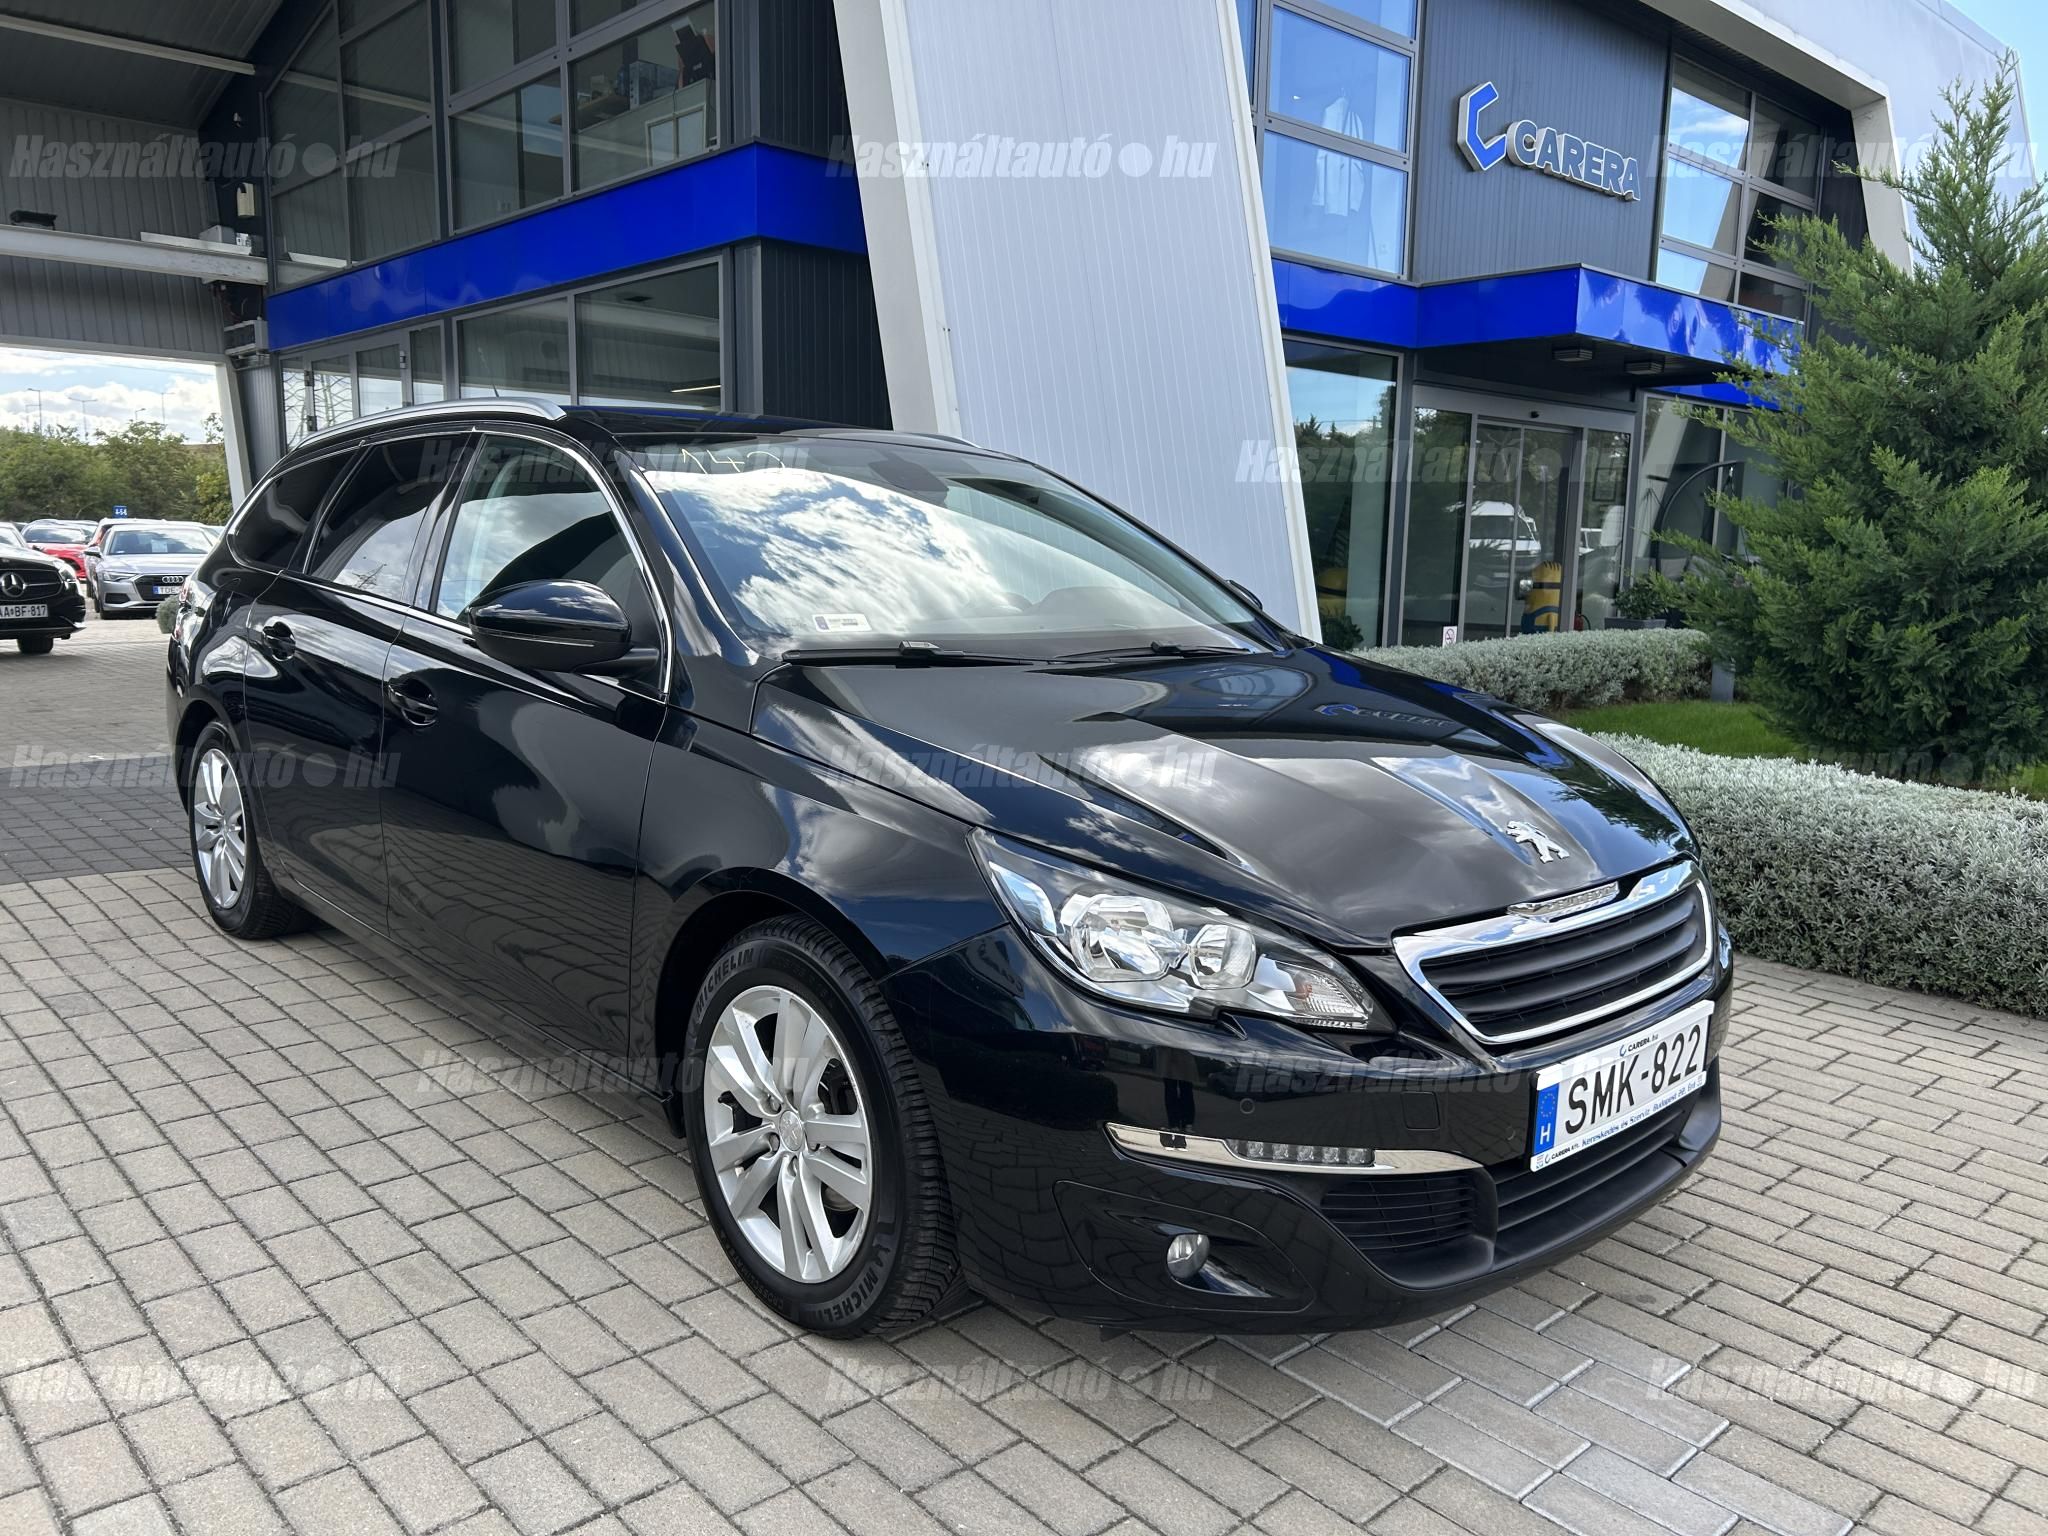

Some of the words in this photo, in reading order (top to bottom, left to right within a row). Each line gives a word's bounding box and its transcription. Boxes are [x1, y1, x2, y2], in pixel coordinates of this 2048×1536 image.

[1507, 120, 1641, 201] CARERA
[696, 947, 754, 1017] MICHELIN
[1565, 1024, 1701, 1134] SMK-822
[1540, 1122, 1551, 1145] H
